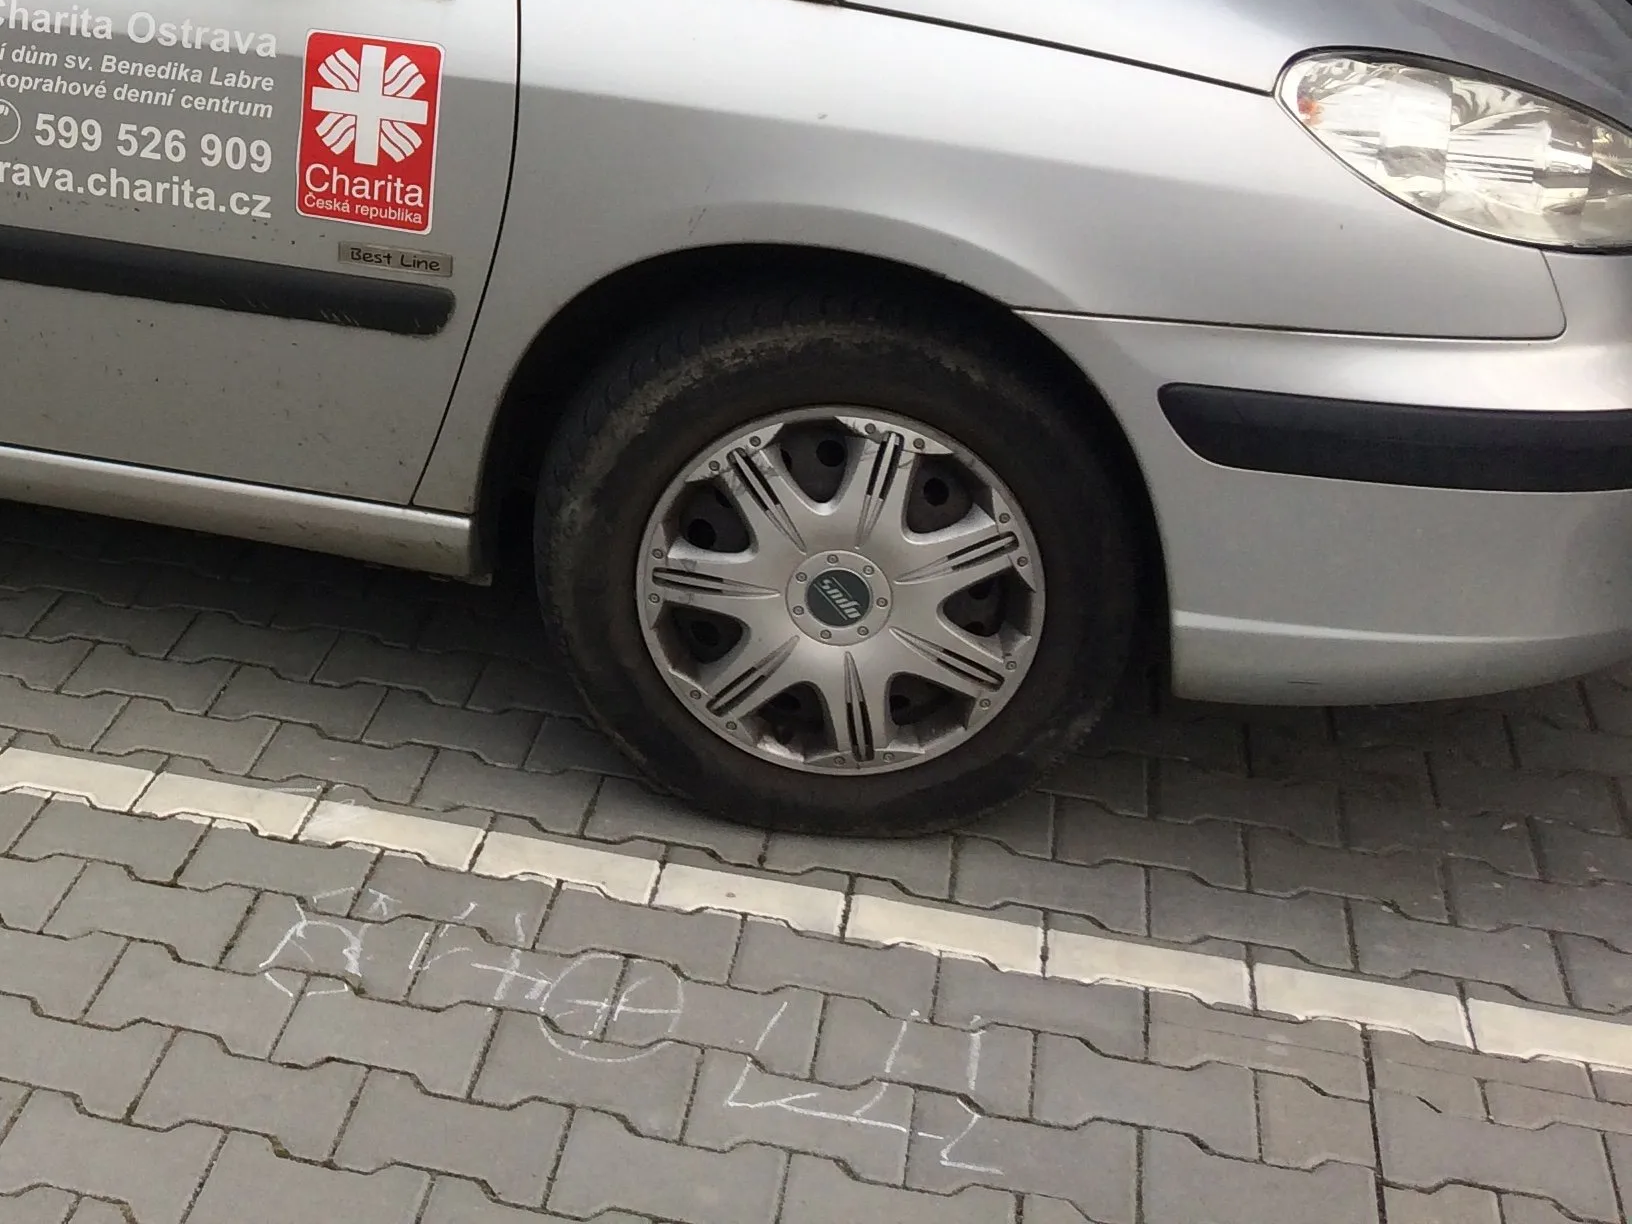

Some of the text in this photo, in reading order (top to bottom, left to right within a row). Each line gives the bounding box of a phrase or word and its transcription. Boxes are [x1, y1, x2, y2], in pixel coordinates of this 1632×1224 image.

[127, 11, 279, 59] Ostrava
[11, 43, 58, 68] dům
[64, 54, 94, 71] sv.
[100, 54, 203, 85] Benedika
[209, 67, 275, 93] Labre
[113, 84, 176, 107] denní
[180, 92, 274, 118] centrum
[34, 112, 273, 174] 599 526 909
[304, 191, 422, 225] Česká republika
[305, 163, 424, 208] Charita
[350, 247, 441, 272] Best Line
